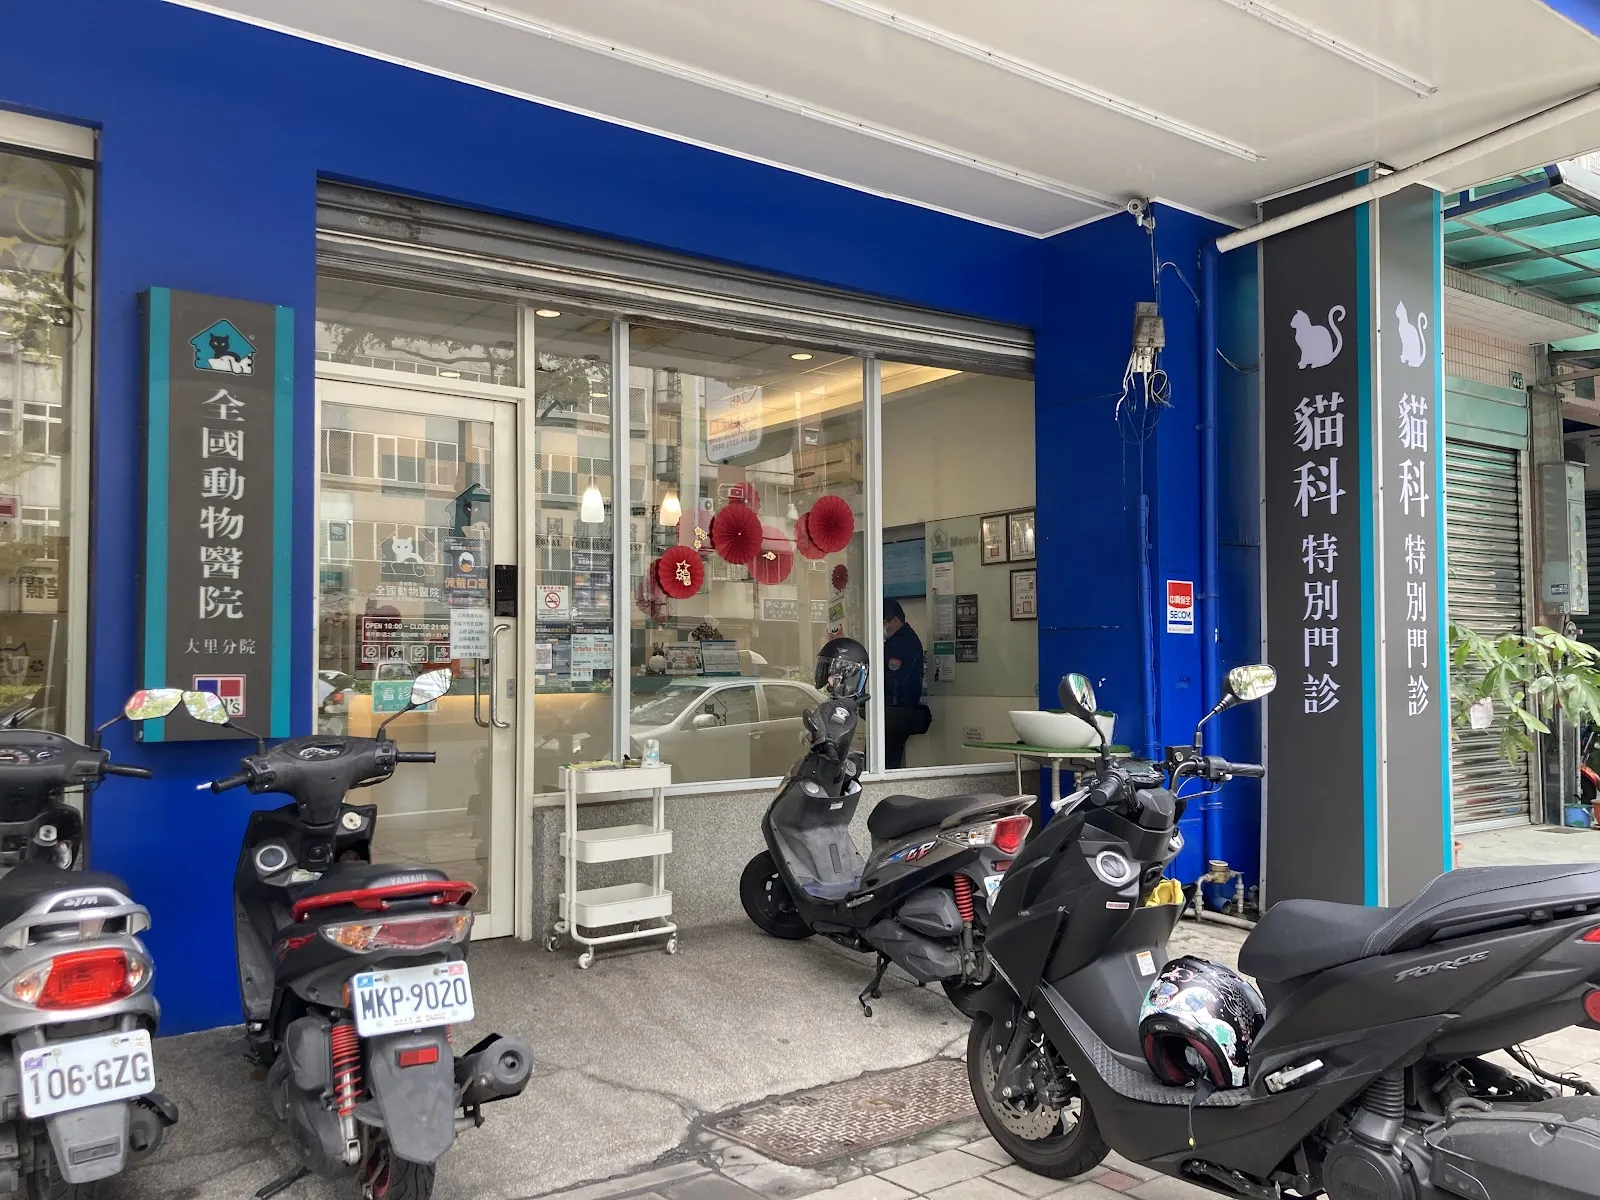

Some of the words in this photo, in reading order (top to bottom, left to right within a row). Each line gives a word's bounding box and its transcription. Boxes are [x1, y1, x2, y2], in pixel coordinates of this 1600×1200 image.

[1513, 378, 1523, 389] 443
[1293, 391, 1346, 518] 貓科
[1398, 392, 1429, 518] 貓科
[199, 389, 245, 620] 全國動物醫院
[375, 585, 440, 598] 全國動物醫院
[1169, 610, 1192, 619] SECOM
[365, 622, 382, 630] OPEN
[384, 622, 402, 630] 10:00
[1301, 533, 1340, 715] 特別門診
[1404, 533, 1429, 716] 特別門診
[184, 638, 256, 654] 大里分院
[391, 873, 428, 886] YAMAHA
[63, 896, 98, 907] SYM
[1394, 950, 1490, 984] FORCE
